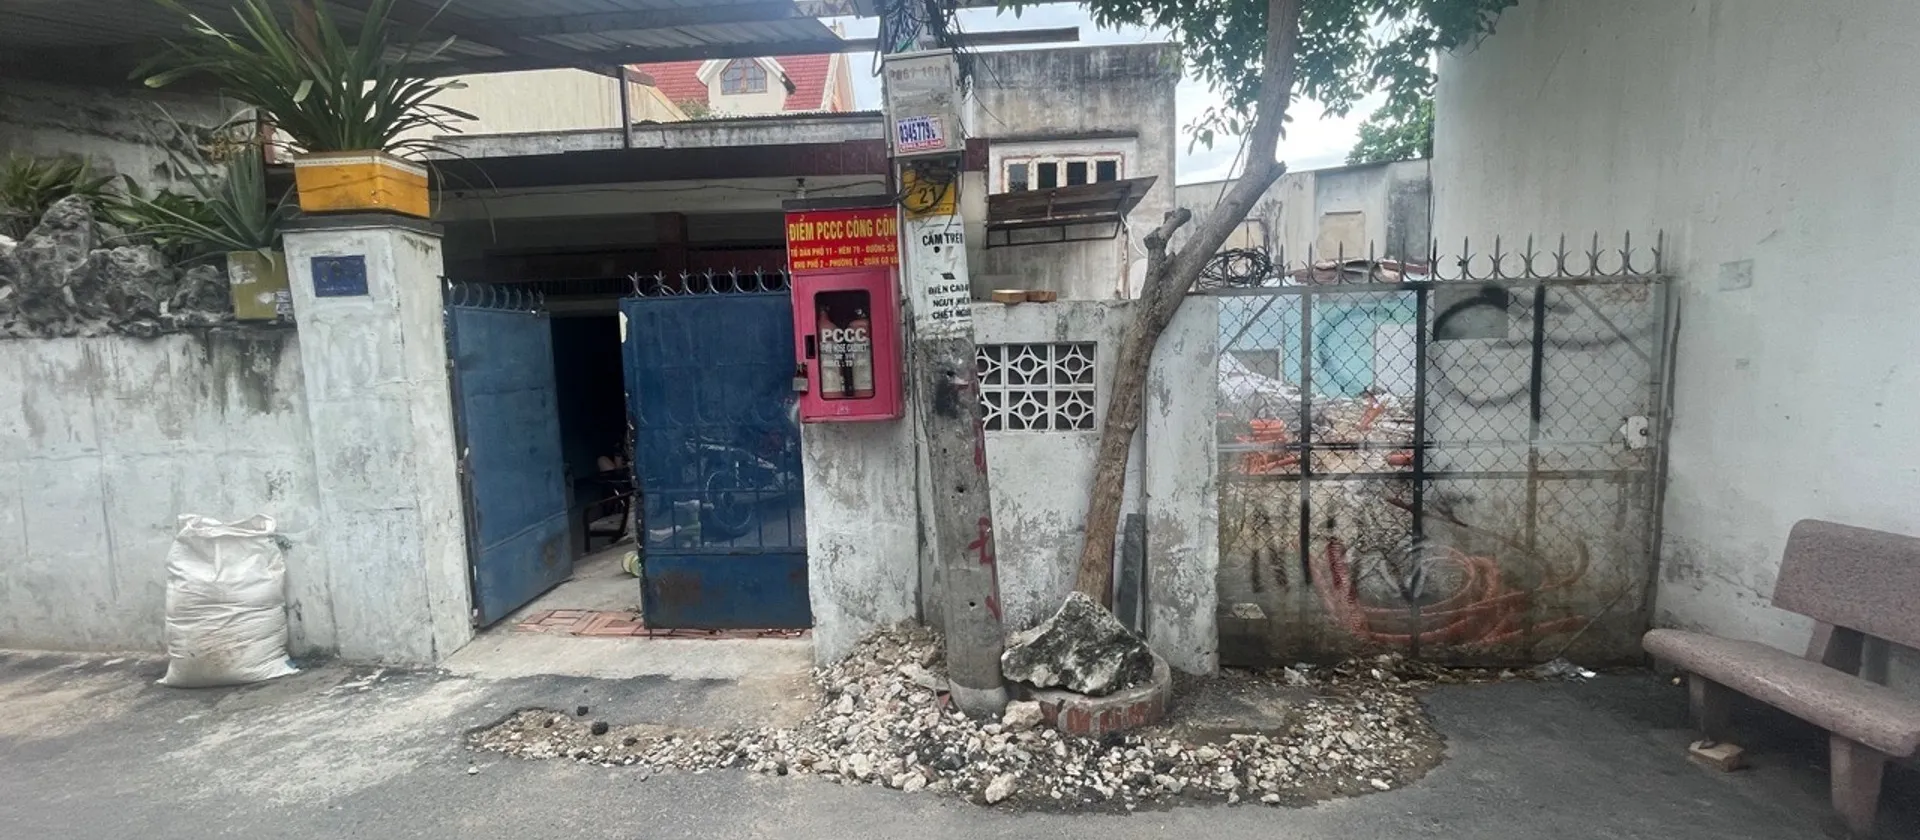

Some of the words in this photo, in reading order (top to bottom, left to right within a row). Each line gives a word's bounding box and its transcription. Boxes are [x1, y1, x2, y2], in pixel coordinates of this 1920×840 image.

[789, 214, 814, 241] ĐIỂM
[816, 220, 843, 240] PCCC
[846, 215, 873, 238] CÔNG
[876, 213, 897, 240] CỘN
[821, 327, 867, 343] PCCC
